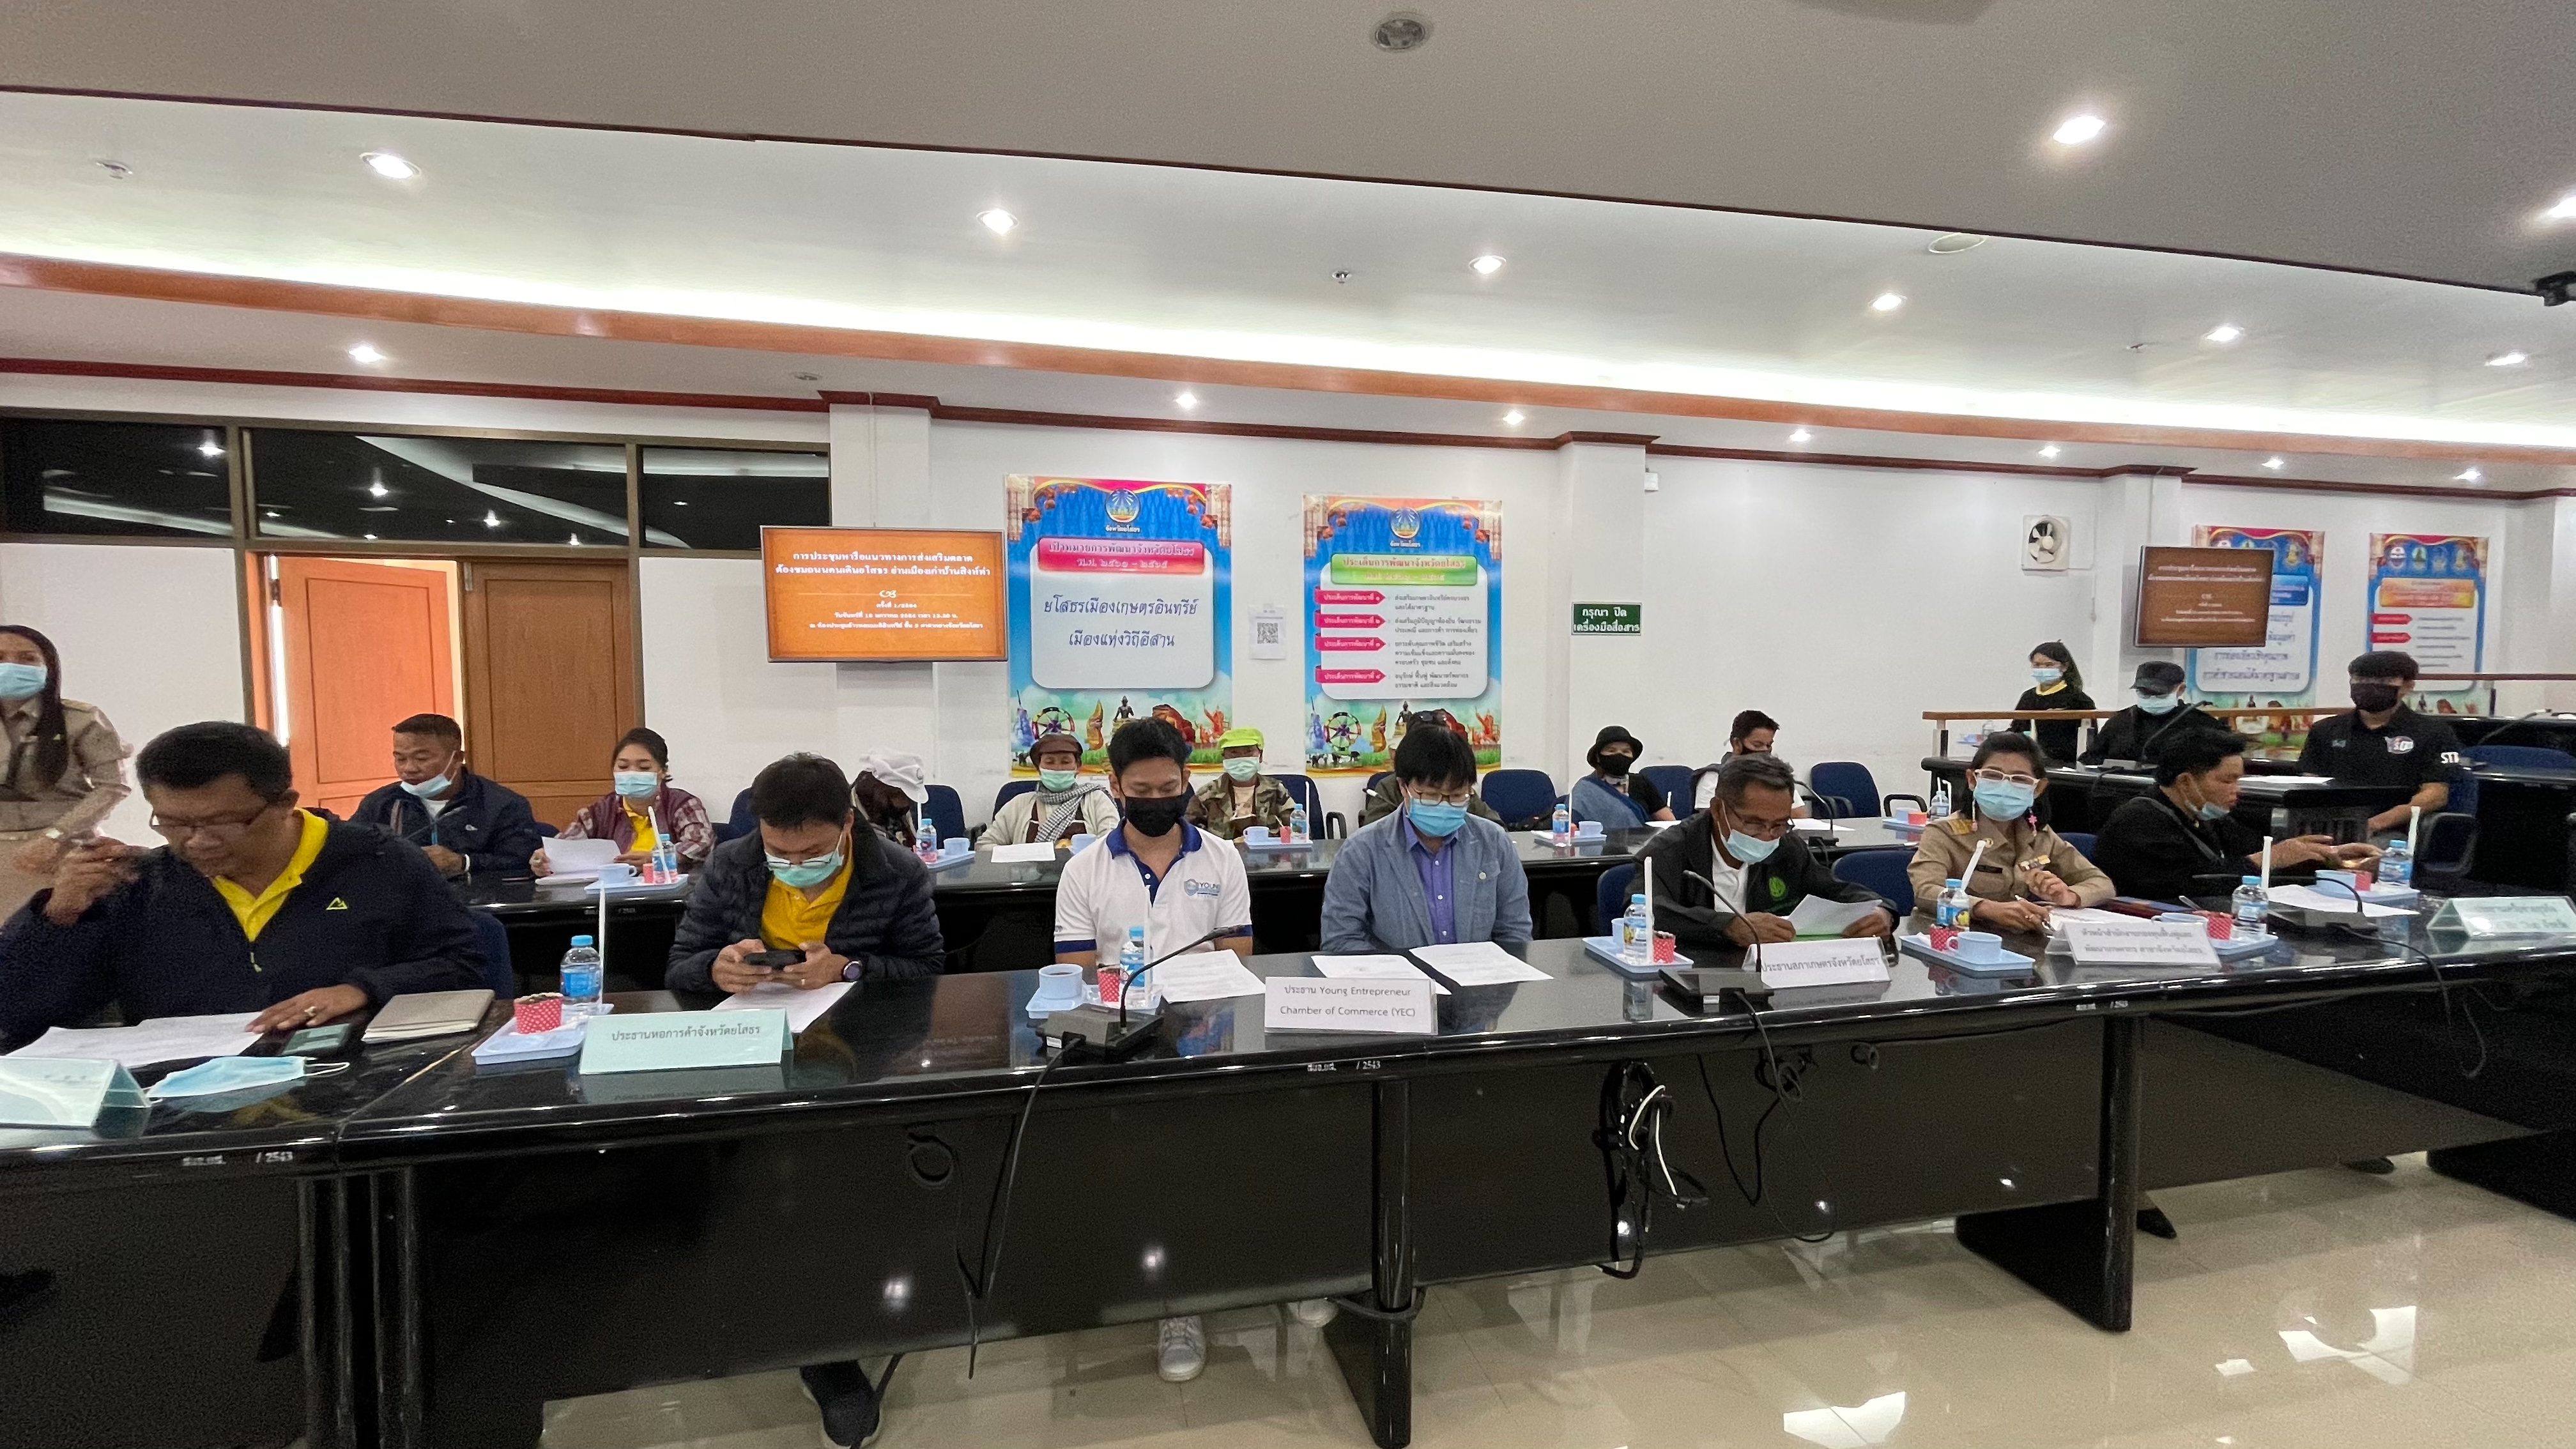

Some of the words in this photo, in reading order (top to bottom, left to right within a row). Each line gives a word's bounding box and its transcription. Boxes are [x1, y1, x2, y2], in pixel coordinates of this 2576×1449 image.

[1044, 595, 1199, 617] ยโสธรเมืองเกษตรอินทรีย์
[1582, 608, 1609, 619] กรุณา
[1613, 606, 1627, 617] ปิด
[1573, 618, 1640, 632] เครื่องมือสื่อสาร
[1069, 629, 1175, 648] เมืองแห่งวิถีอีสาน
[1284, 985, 1316, 994] ประธาน
[1320, 986, 1348, 997] Young
[1351, 986, 1411, 997] Entrepreneur
[1280, 1006, 1322, 1015] Chamber
[1325, 1006, 1336, 1015] of
[1338, 1007, 1388, 1016] Commerce
[1391, 1008, 1416, 1017] (YEC)
[611, 1023, 760, 1041] ประธานหอการค้าจังหวัดยโสธร
